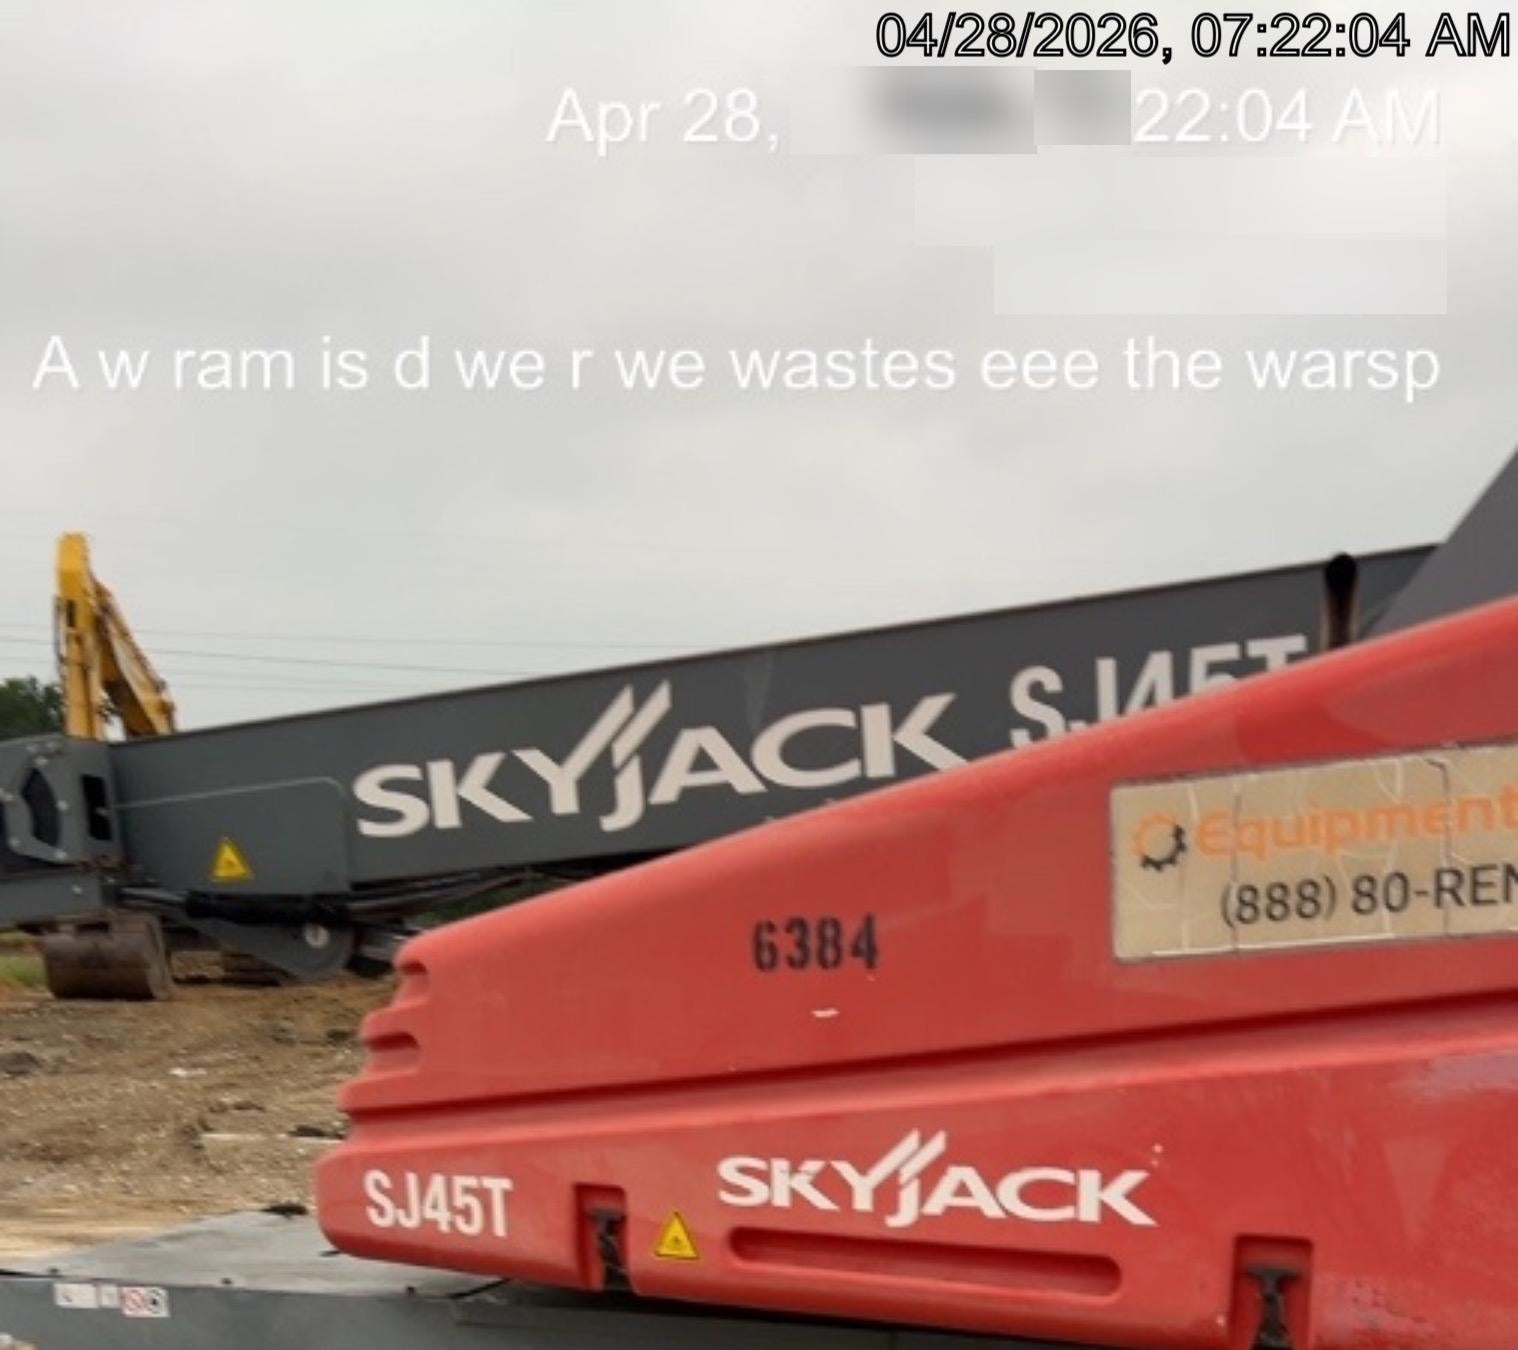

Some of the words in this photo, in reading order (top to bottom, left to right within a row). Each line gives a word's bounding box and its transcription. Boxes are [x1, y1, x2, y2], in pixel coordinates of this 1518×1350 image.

[353, 680, 970, 837] SKYJACK
[1221, 876, 1337, 928] (888)
[753, 912, 879, 972] 6384
[363, 1169, 514, 1237] SJ45T
[717, 1128, 1158, 1228] SKYJACK
